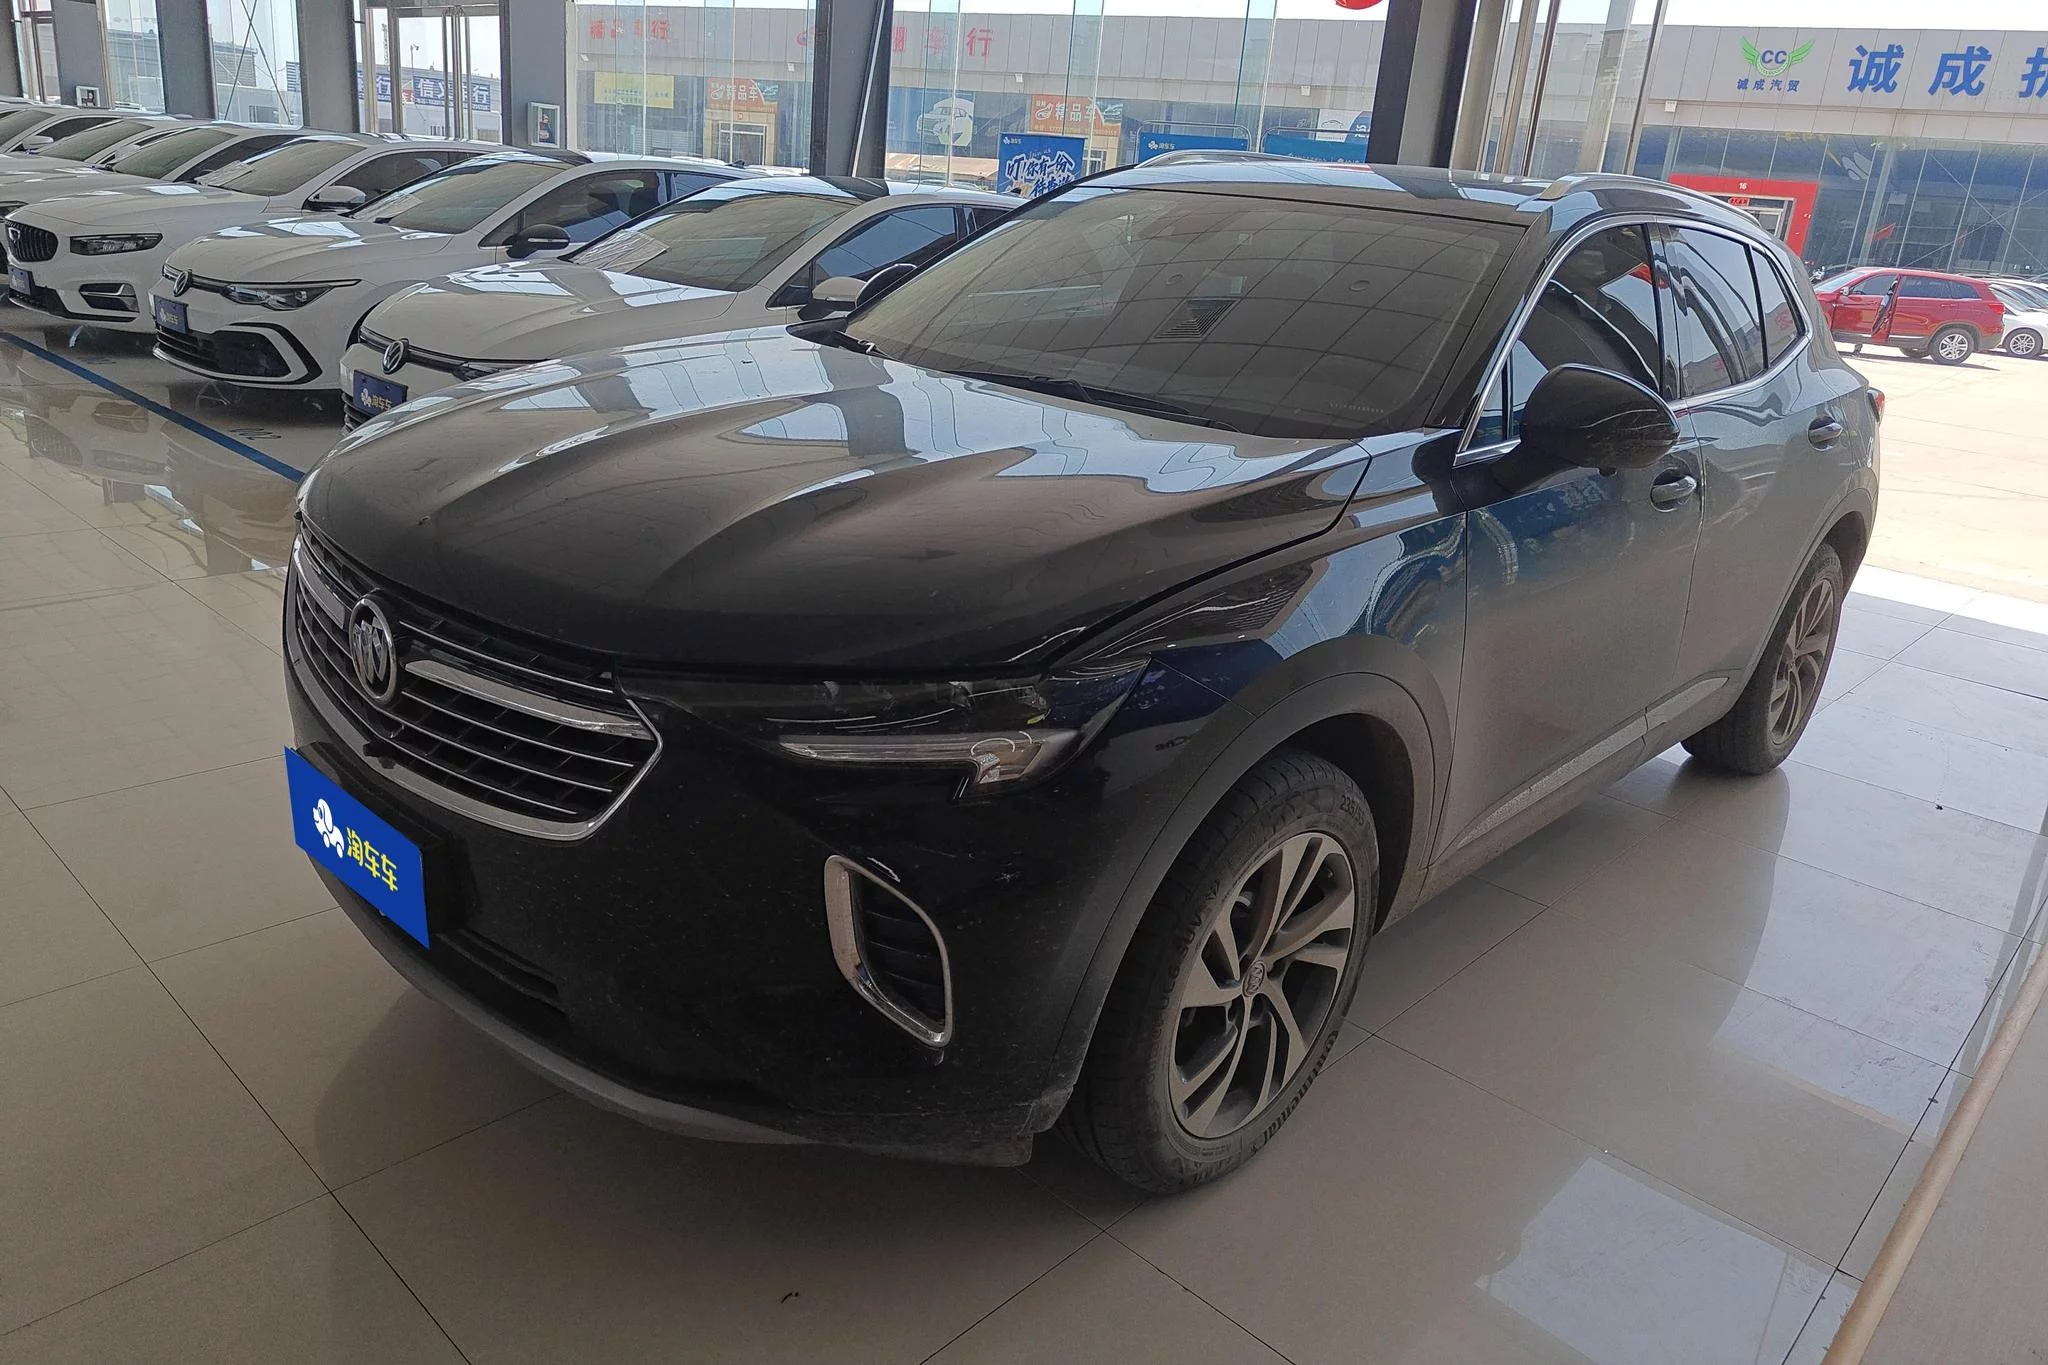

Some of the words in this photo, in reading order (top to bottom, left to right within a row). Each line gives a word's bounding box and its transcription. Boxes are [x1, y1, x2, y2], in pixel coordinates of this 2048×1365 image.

[1761, 50, 1788, 64] CC
[1737, 78, 1800, 92] 诚成汽贸
[346, 826, 399, 892] 淘车车
